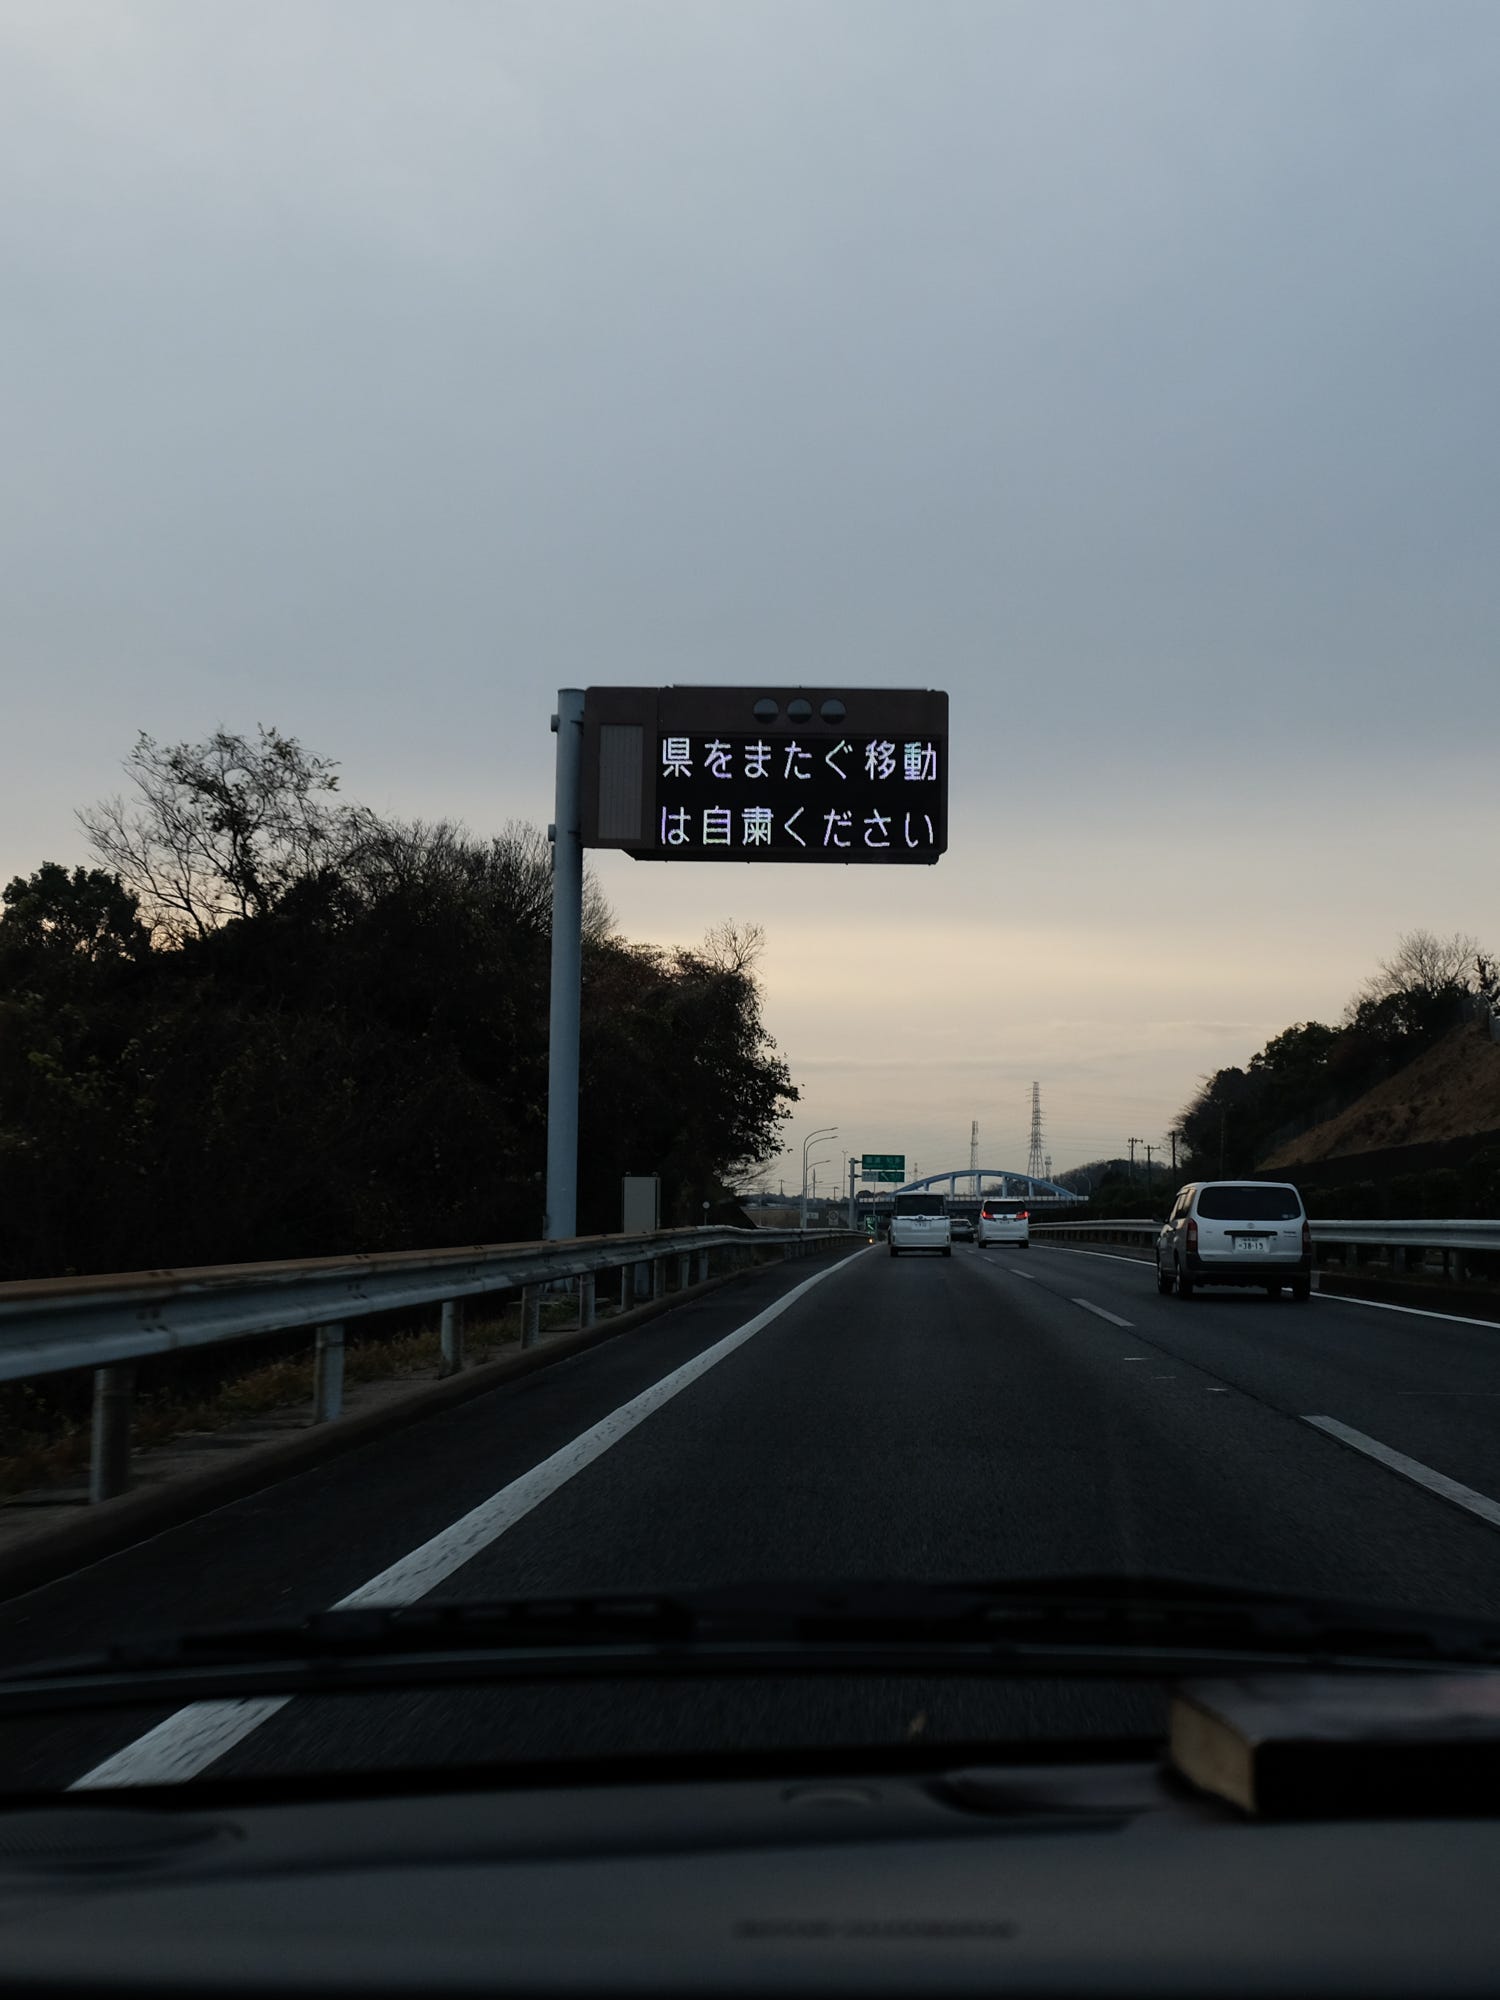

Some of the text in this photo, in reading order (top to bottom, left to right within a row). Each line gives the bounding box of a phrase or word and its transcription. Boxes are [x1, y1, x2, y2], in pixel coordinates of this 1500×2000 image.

[662, 737, 937, 782] 県をまたぐ移動
[661, 805, 934, 848] は自粛ください
